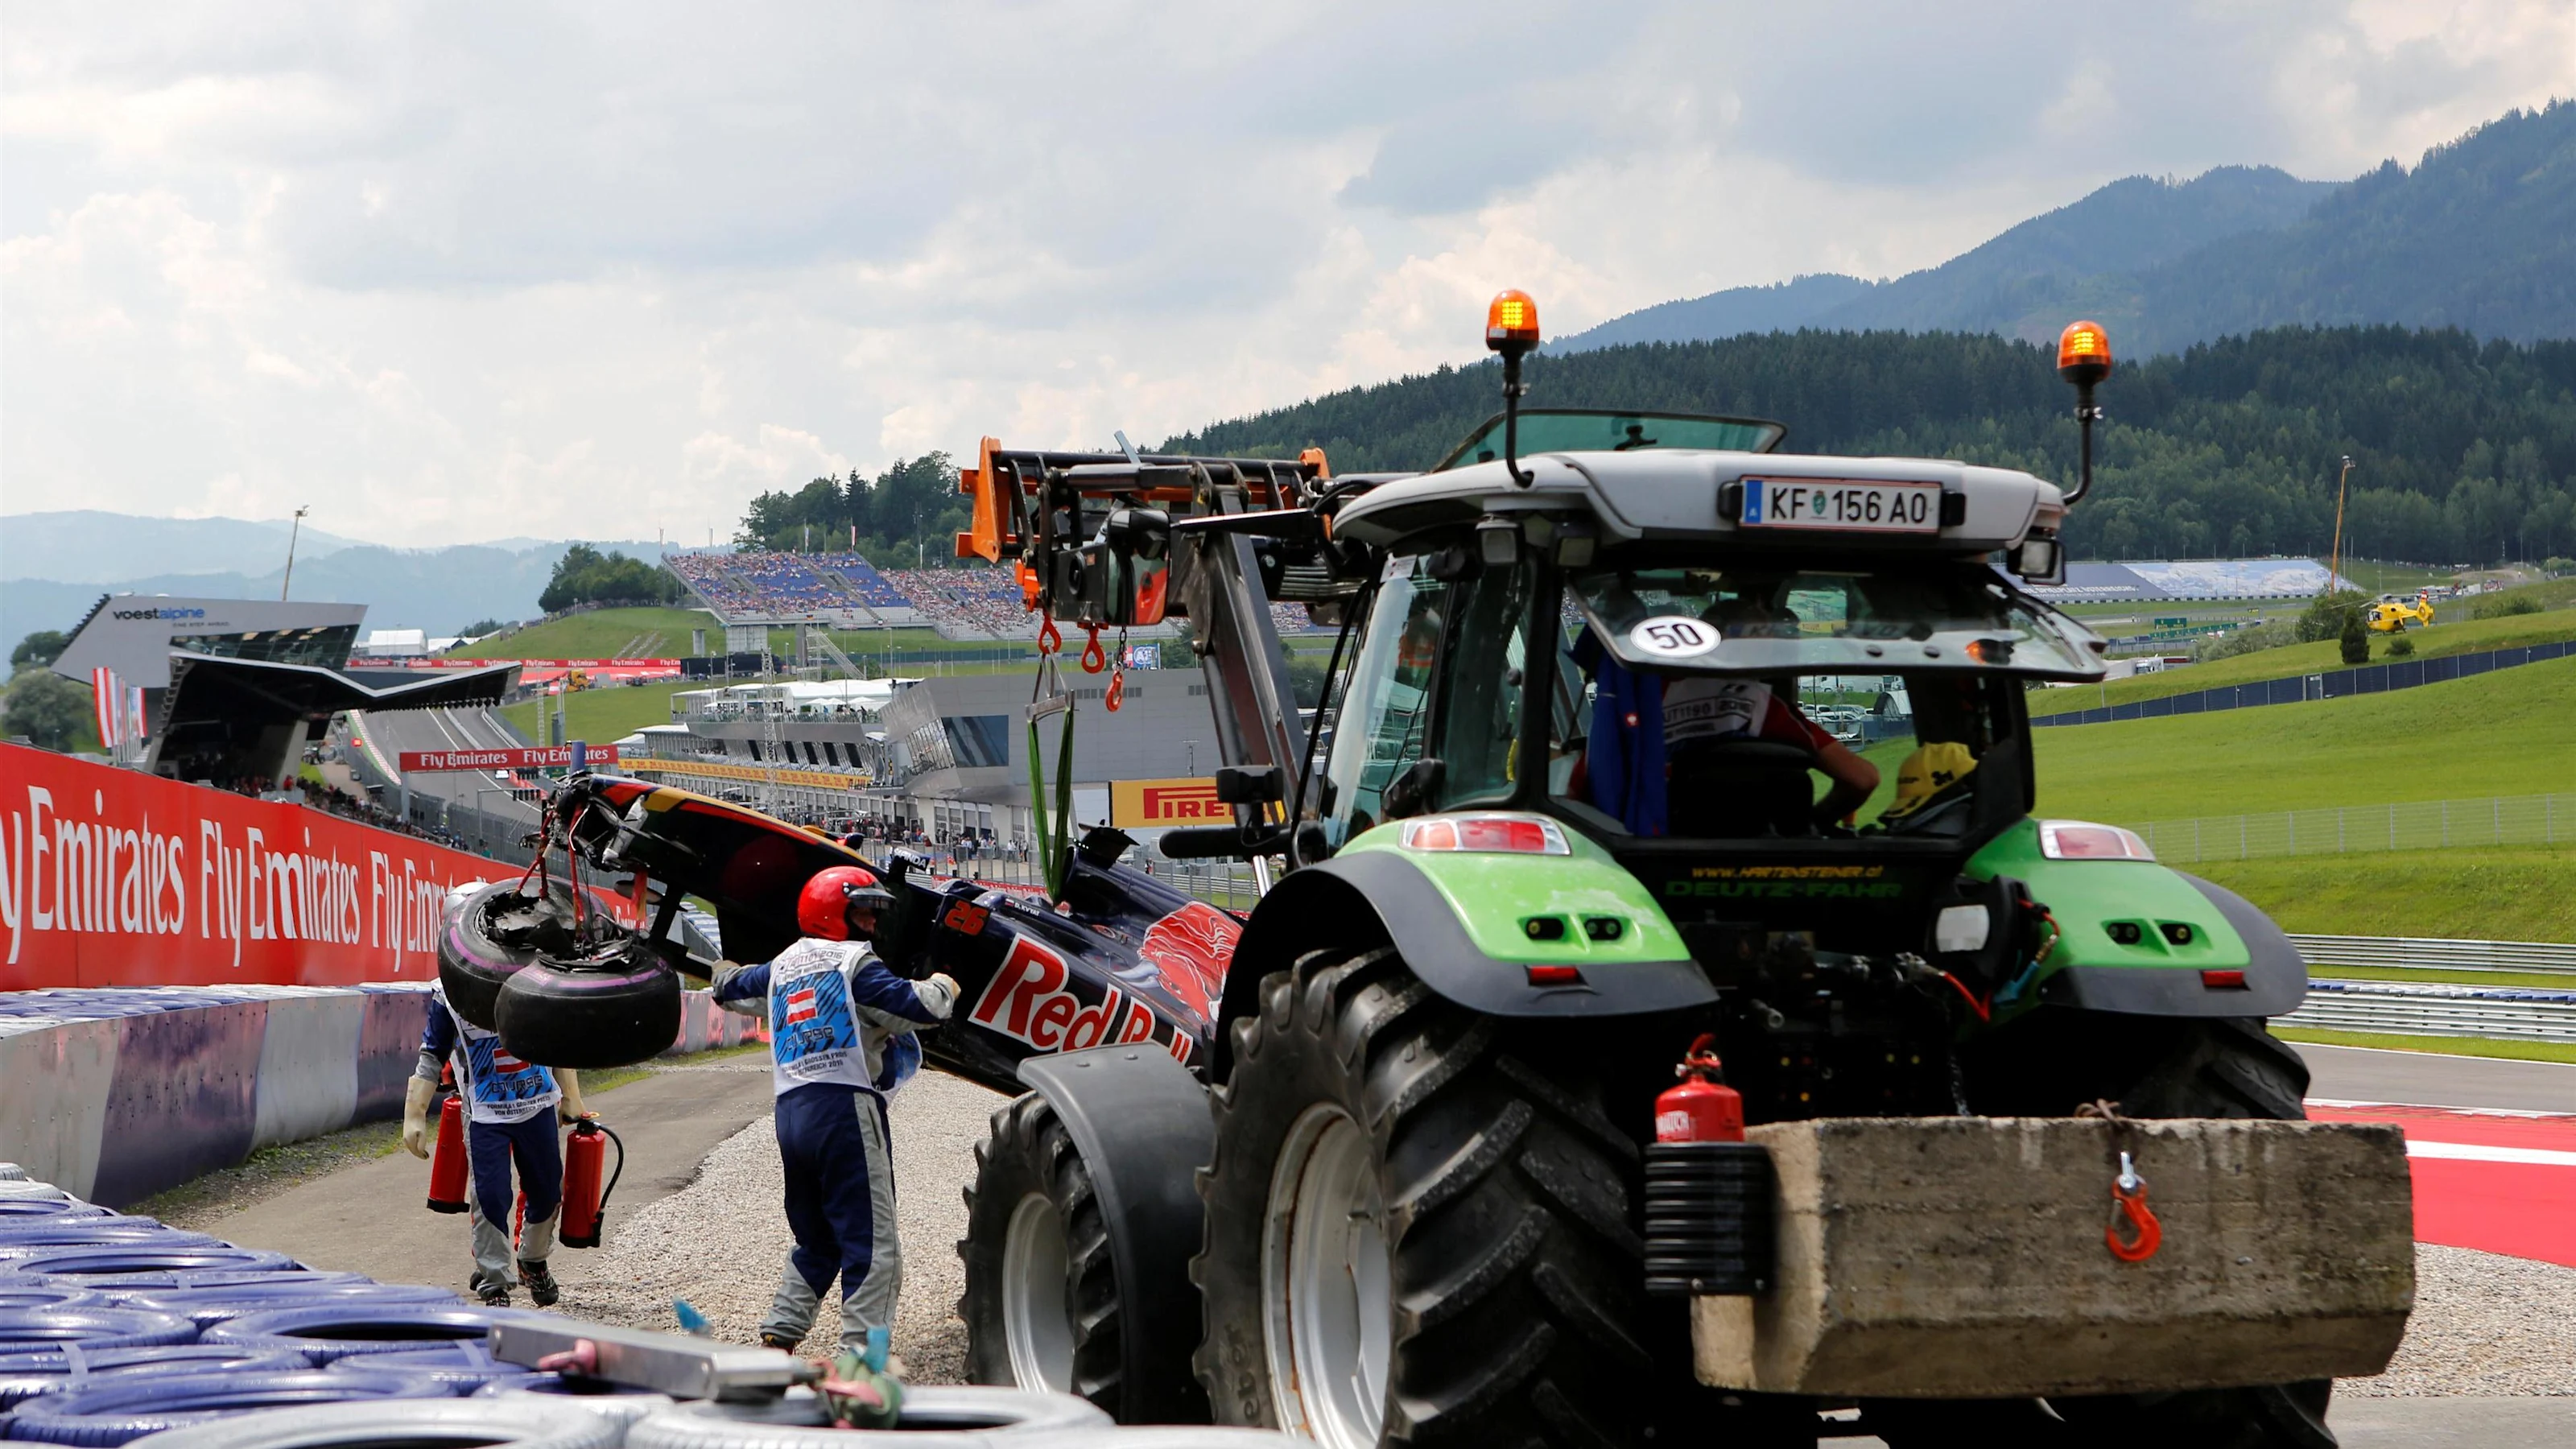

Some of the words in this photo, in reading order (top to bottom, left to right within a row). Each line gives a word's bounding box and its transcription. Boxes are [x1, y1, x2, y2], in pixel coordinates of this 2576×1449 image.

[1772, 487, 1807, 520] KF
[1832, 489, 1882, 522] 156
[114, 607, 205, 621] voestalpine
[1645, 622, 1704, 650] 50
[420, 753, 444, 769] Fly
[447, 750, 509, 768] Emirates
[523, 749, 547, 765] Fly
[27, 784, 186, 935] Emirates
[200, 818, 242, 968] Fly
[246, 825, 361, 945] Emirates
[370, 850, 403, 972] Fly
[1664, 880, 1905, 898] DEUTZ-FAHR
[944, 900, 989, 937] 26
[972, 935, 1119, 1053] Red
[490, 1075, 544, 1094] COURSE
